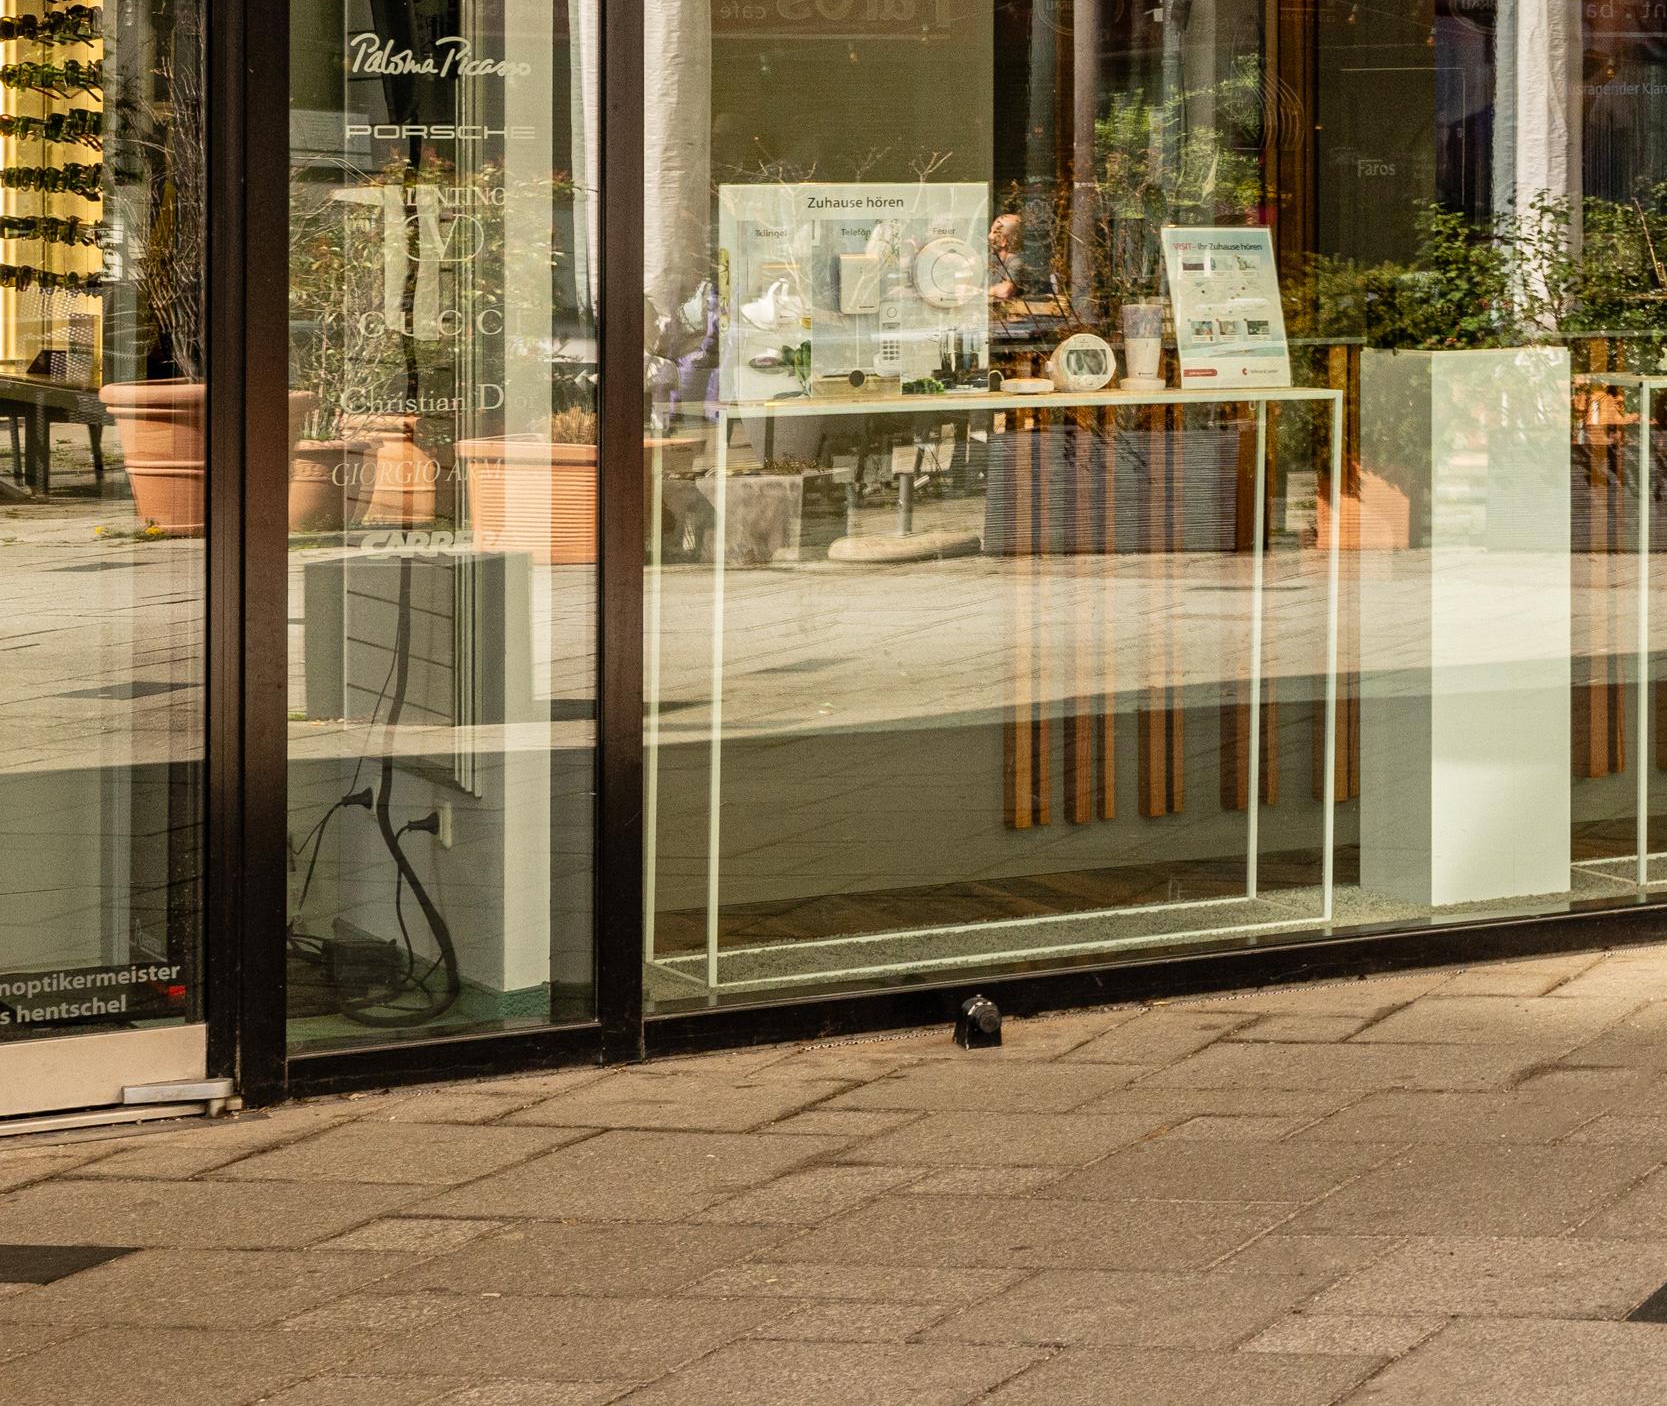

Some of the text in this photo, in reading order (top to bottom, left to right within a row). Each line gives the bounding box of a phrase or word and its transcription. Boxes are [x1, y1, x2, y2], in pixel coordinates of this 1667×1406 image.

[350, 33, 531, 78] Paloma Picasso
[346, 125, 536, 140] PORSCHE
[807, 195, 904, 209] Zuhause hören
[340, 388, 467, 414] Christian
[331, 460, 440, 487] GIORGIO
[17, 994, 127, 1024] hentschel
